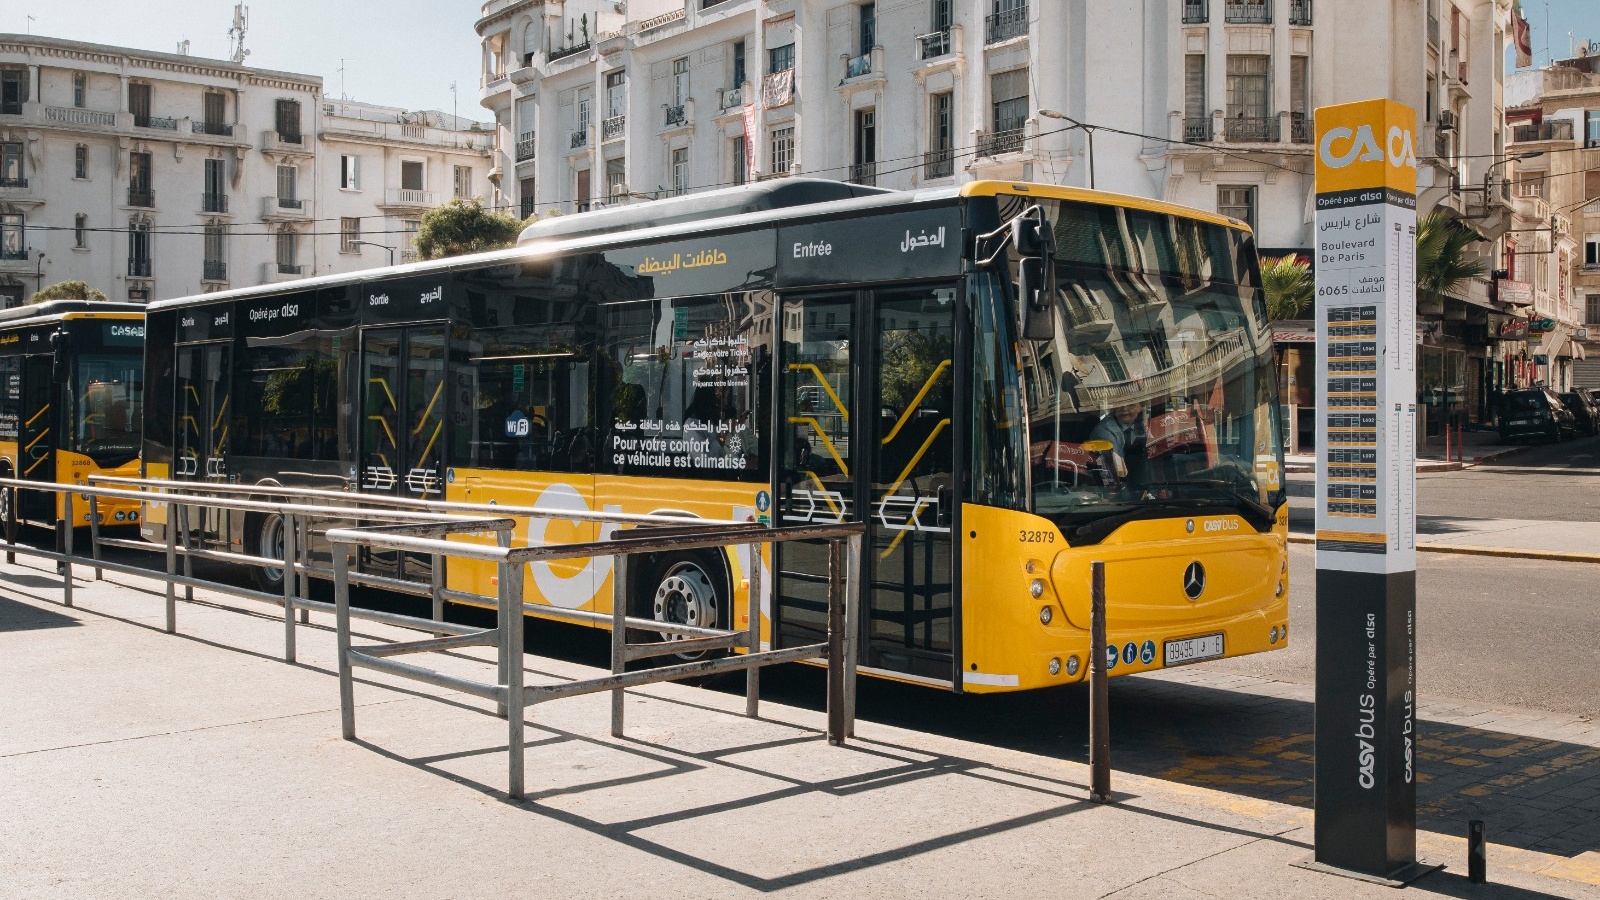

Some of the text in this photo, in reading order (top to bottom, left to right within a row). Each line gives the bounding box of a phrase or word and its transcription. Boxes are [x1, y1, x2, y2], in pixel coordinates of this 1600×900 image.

[1320, 125, 1384, 168] CA
[1387, 126, 1416, 169] CA
[1318, 192, 1382, 206] Opéré par alsa
[1405, 196, 1415, 206] alsa
[1320, 216, 1350, 232] باريس
[1355, 212, 1381, 230] شارع
[900, 226, 946, 252] الدخول
[1321, 238, 1375, 250] Boulevard
[794, 240, 832, 258] Entrée
[638, 248, 726, 274] حافلات البيضاء
[1322, 252, 1364, 263] De Paris
[1358, 276, 1384, 284] موقف
[420, 286, 442, 304] الخروج
[1318, 286, 1348, 296] 6065
[1352, 284, 1384, 294] الحافلات
[370, 294, 388, 306] Sortie
[250, 303, 298, 322] Opéré par alsa
[182, 317, 194, 326] Sortie
[730, 348, 748, 357] Ticket
[614, 418, 637, 430] مكيفة
[640, 419, 662, 432] الحافلة
[666, 420, 680, 430] هذه
[735, 420, 746, 432] من
[614, 436, 710, 452] Pour votre confort
[614, 452, 746, 469] ce véhicule est climatisé
[1019, 530, 1055, 544] 32879
[1366, 613, 1376, 638] alsa
[1170, 640, 1194, 660] 89495
[1368, 642, 1376, 658] par
[1366, 660, 1376, 689] Opéré
